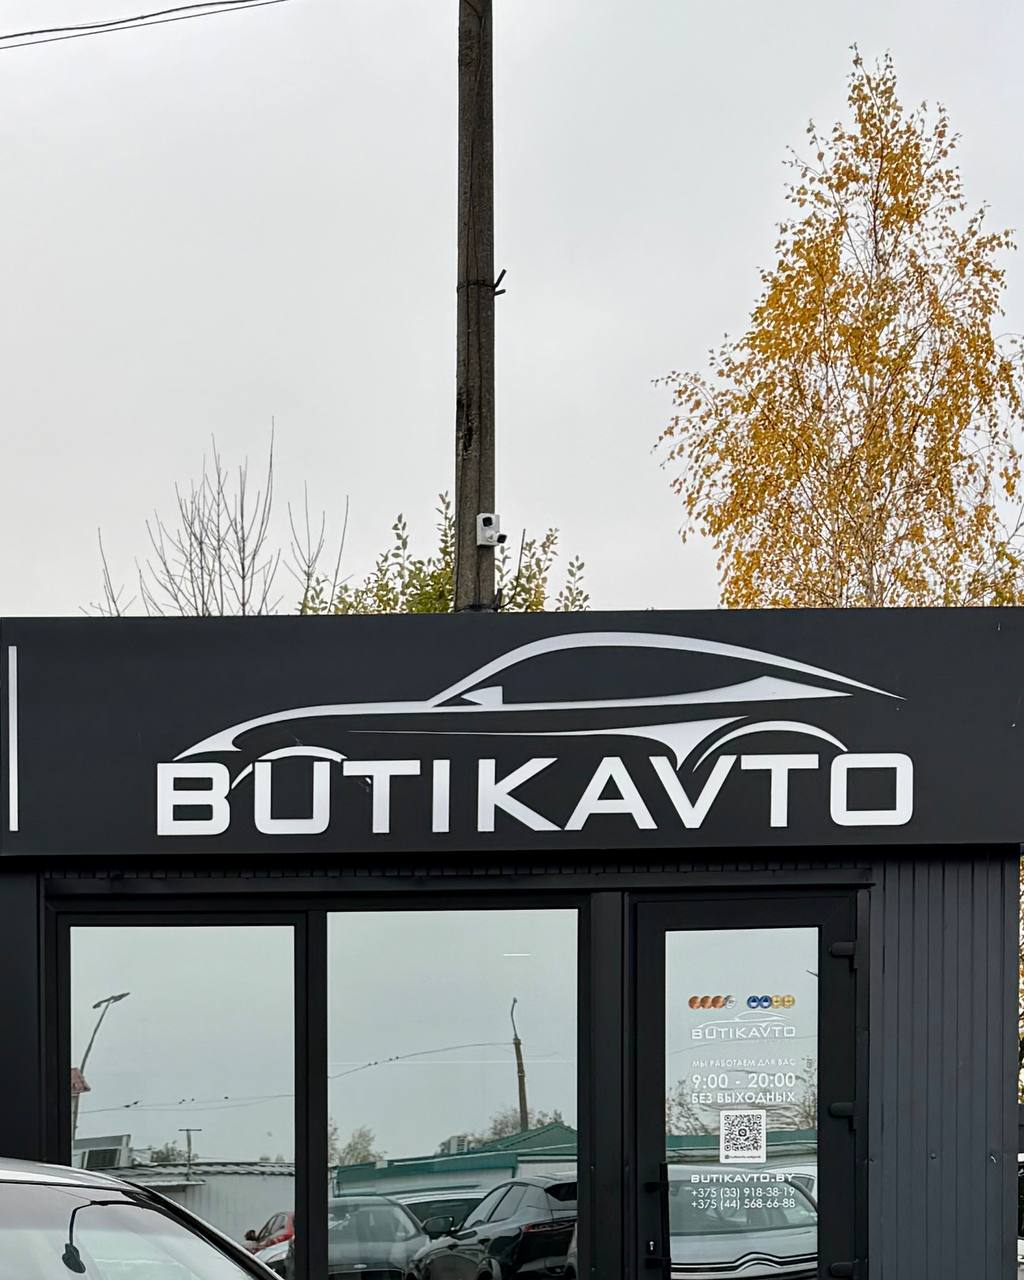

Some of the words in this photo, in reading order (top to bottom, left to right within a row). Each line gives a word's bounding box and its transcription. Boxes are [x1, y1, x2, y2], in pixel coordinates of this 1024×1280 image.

[157, 752, 914, 836] BUTIKAVTO
[691, 1026, 796, 1039] BUTIKAVTO
[692, 1074, 729, 1088] 9:00
[748, 1072, 796, 1088] 20:00
[692, 1093, 713, 1104] БЕЗ
[717, 1091, 795, 1104] ВЫХОДНЫХ
[691, 1173, 795, 1183] BUTIKAVTO.BY
[691, 1187, 717, 1198] +375
[720, 1187, 740, 1199] (33)
[743, 1187, 795, 1197] 918-38-19
[691, 1199, 717, 1209] +375
[720, 1199, 740, 1210] (44)
[743, 1198, 796, 1208] 568-66-88
